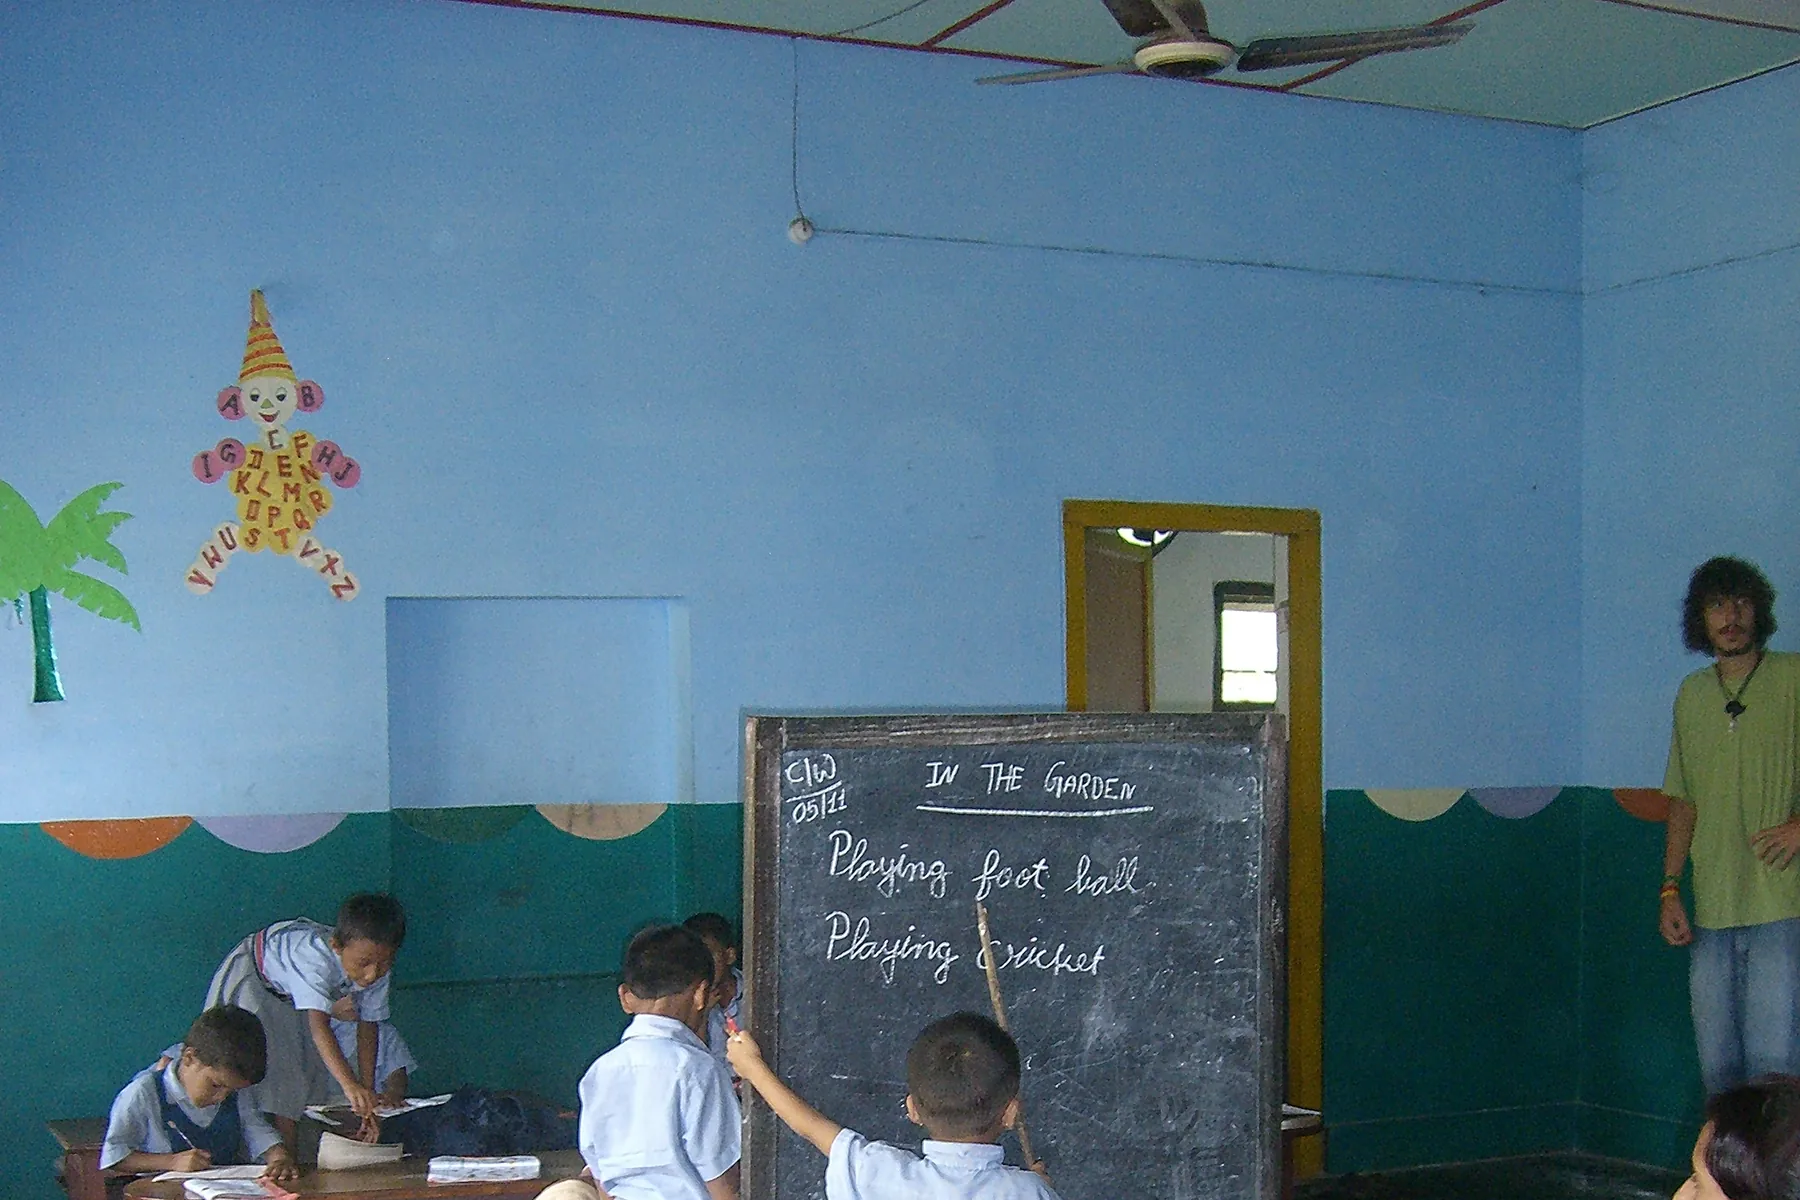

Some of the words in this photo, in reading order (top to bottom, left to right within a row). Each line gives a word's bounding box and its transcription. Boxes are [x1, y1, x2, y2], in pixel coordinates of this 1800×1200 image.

[221, 393, 240, 415] A
[300, 385, 316, 407] B
[268, 429, 284, 450] C
[294, 434, 309, 458] F
[220, 443, 237, 464] G
[317, 446, 336, 467] H
[277, 455, 293, 478] E
[300, 460, 321, 484] N
[334, 463, 354, 481] J
[235, 470, 252, 495] K
[256, 471, 272, 498] L
[283, 483, 301, 503] M
[308, 490, 327, 512] R
[268, 506, 281, 528] P
[218, 526, 238, 550] U
[244, 527, 261, 547] S
[273, 527, 291, 550] T
[202, 545, 224, 569] W
[300, 539, 321, 558] V
[320, 554, 340, 576] X
[187, 568, 214, 588] Y
[331, 575, 355, 598] Z
[925, 761, 958, 788] IN
[980, 762, 1023, 791] THE
[1043, 761, 1137, 800] GARDEN
[829, 829, 952, 899] Playing
[972, 849, 1049, 901] foot
[1065, 854, 1142, 896] ball
[825, 911, 960, 985] Playing
